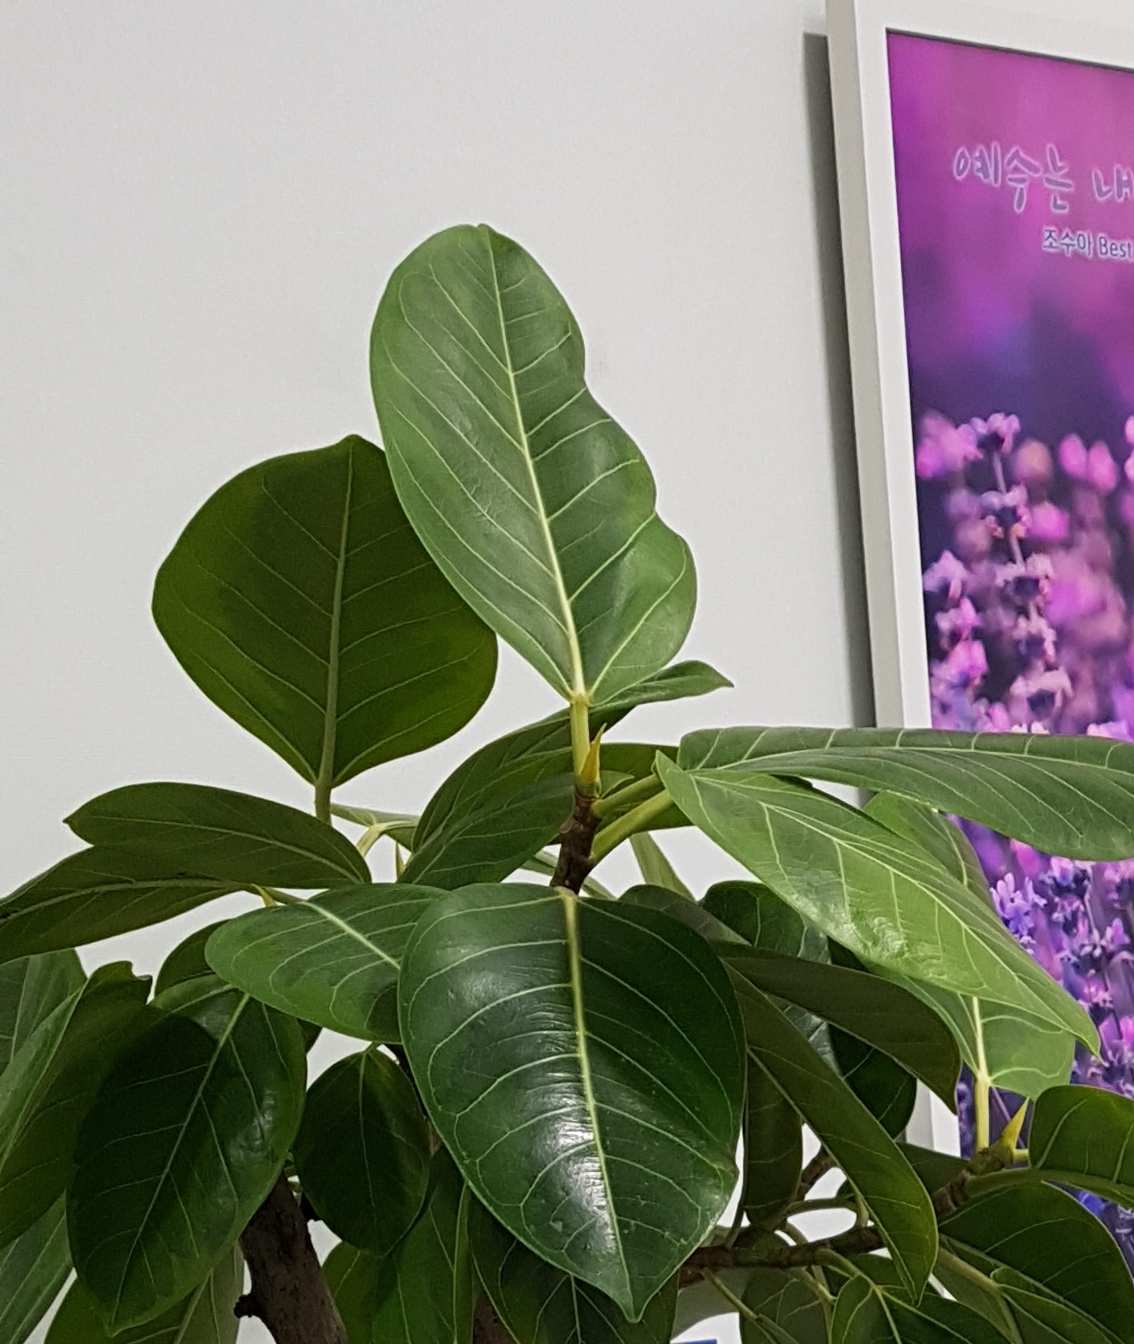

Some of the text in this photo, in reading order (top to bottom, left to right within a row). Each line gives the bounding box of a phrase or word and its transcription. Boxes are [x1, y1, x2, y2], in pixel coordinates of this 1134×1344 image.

[953, 140, 1074, 214] 예수는
[1092, 164, 1134, 201] 내
[1042, 227, 1093, 257] 조수아
[1097, 234, 1133, 261] Best
